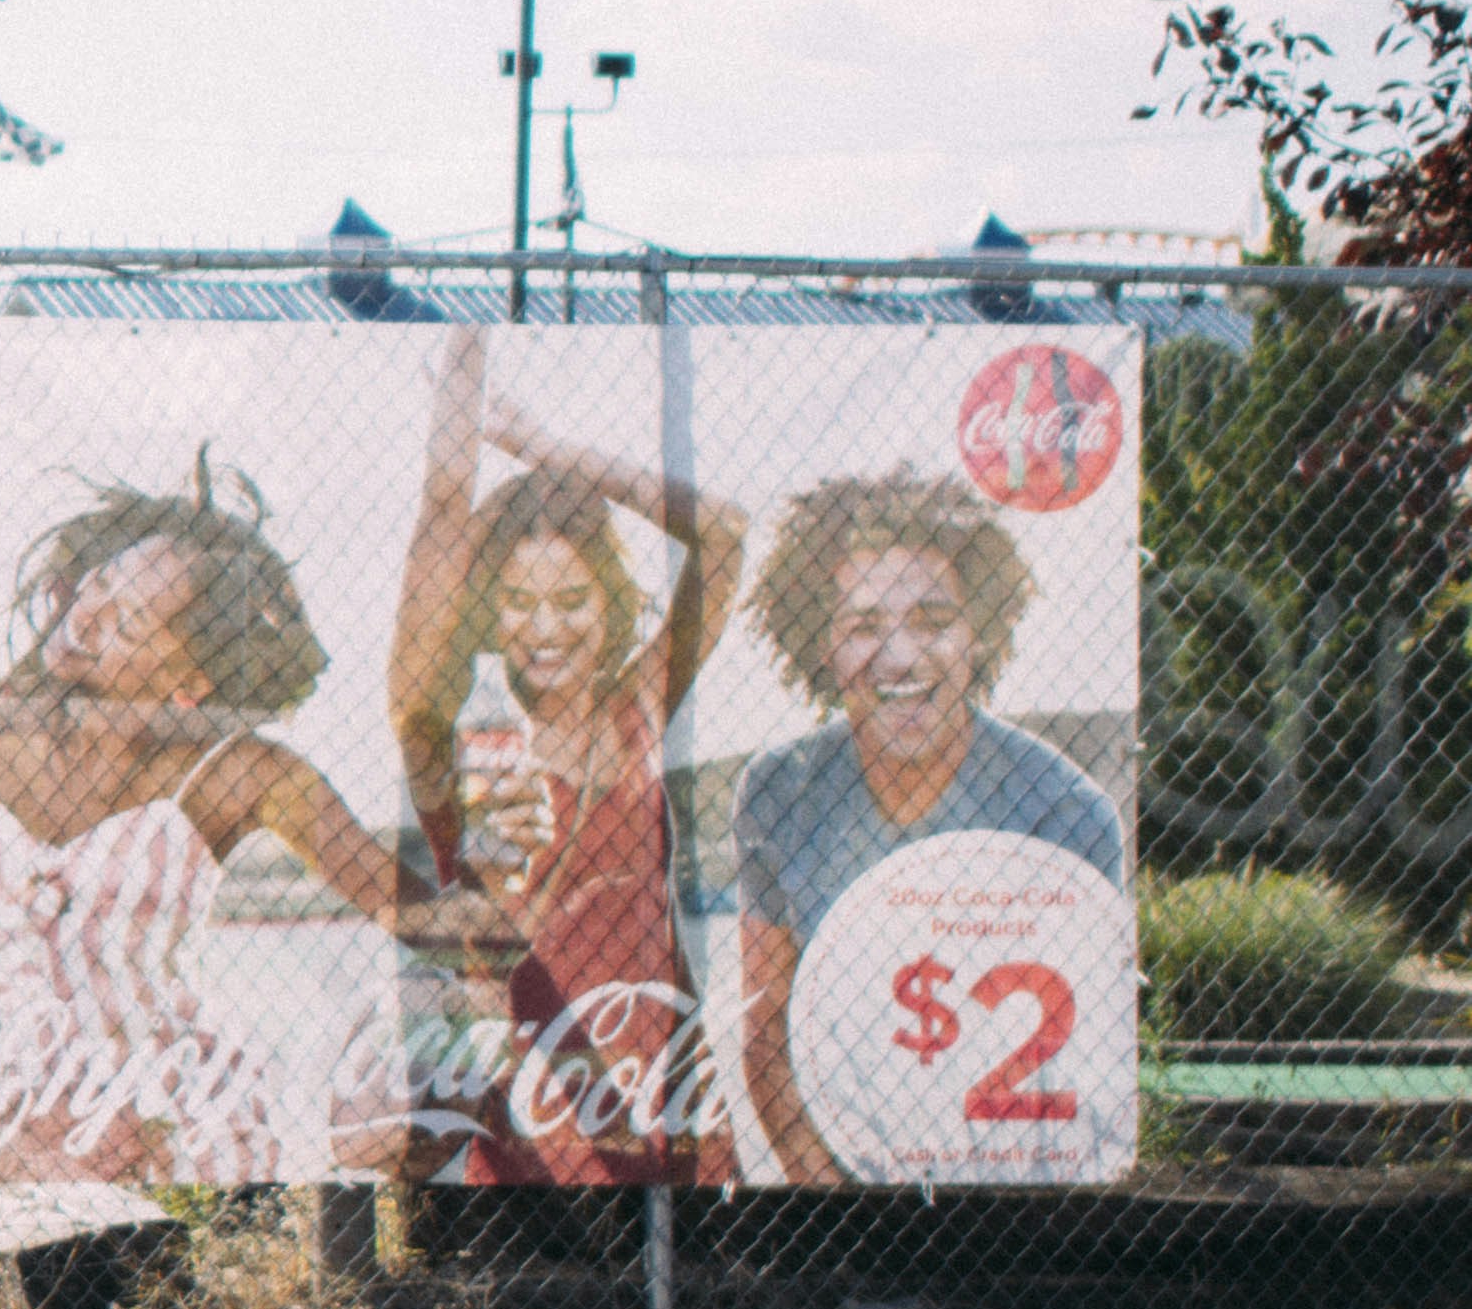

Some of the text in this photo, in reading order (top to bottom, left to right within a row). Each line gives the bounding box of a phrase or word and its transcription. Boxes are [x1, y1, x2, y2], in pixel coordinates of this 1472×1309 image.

[963, 400, 1116, 452] Coca-Cola
[888, 886, 1077, 907] 20oz Coca-Cola
[931, 918, 1038, 937] Products
[891, 952, 1077, 1121] $2
[890, 1147, 1077, 1164] Cash or Credit Card
